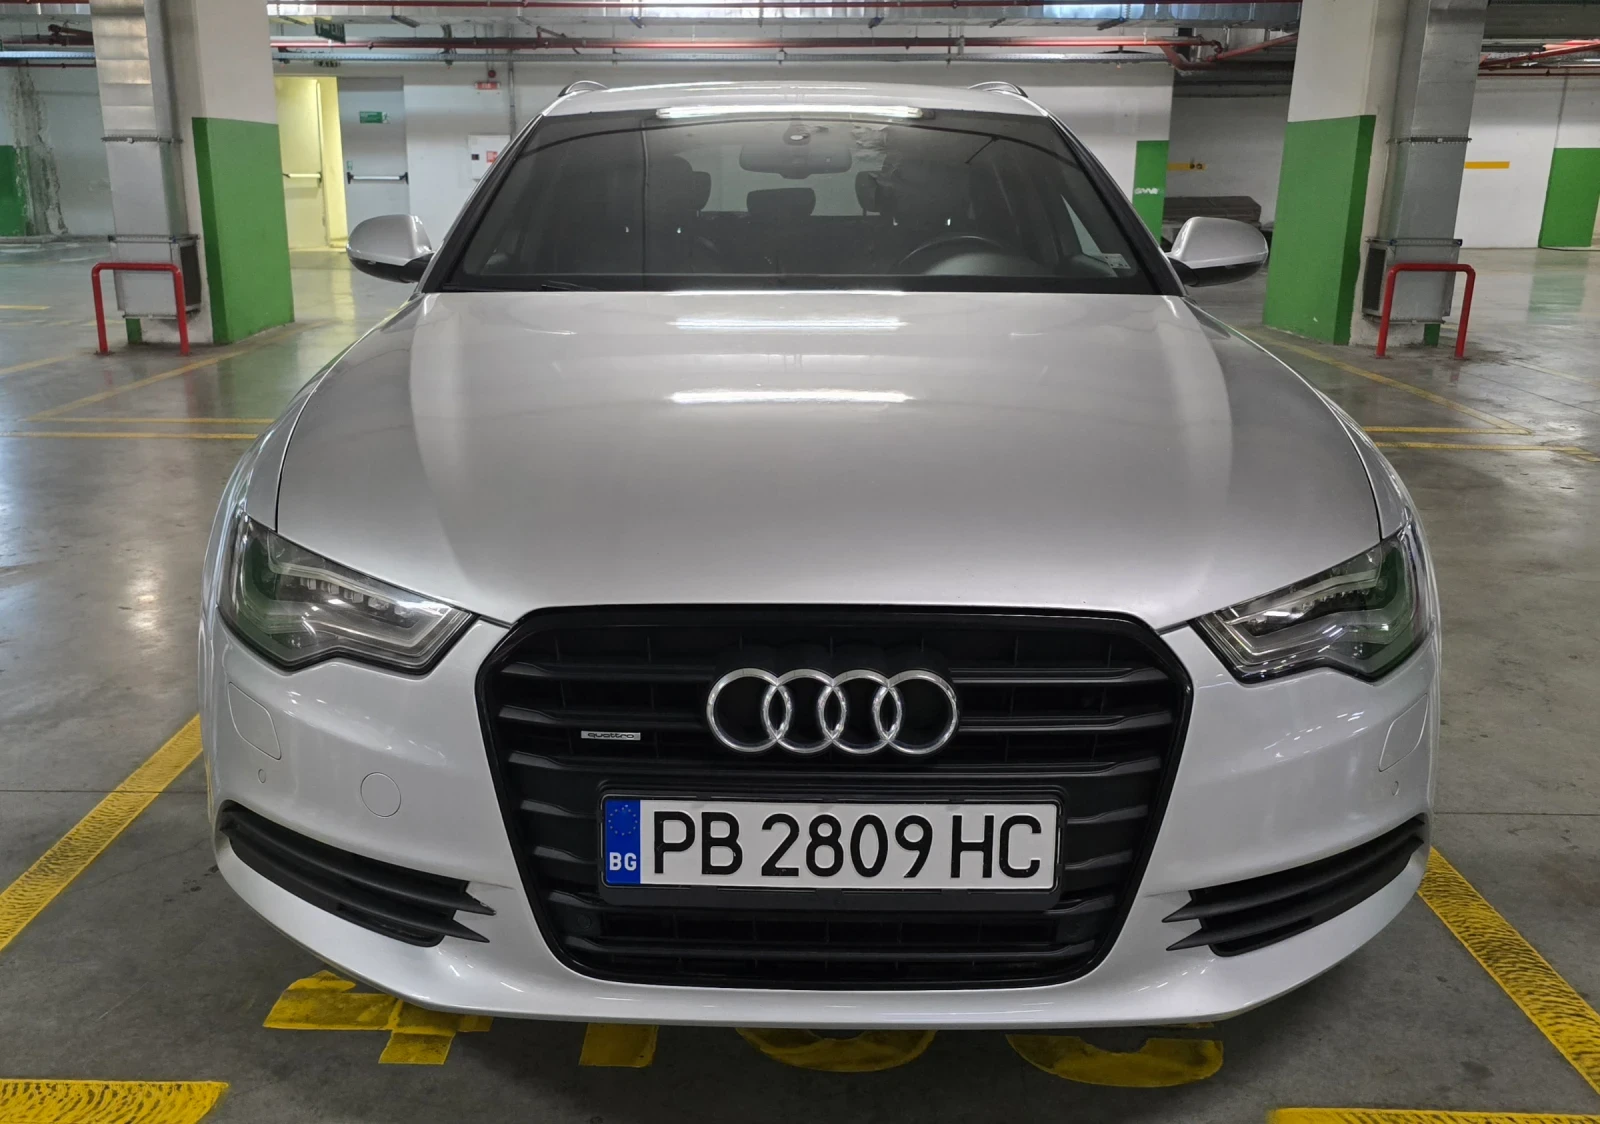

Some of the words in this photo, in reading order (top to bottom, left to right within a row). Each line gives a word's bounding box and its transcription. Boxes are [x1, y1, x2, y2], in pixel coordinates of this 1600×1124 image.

[609, 852, 637, 871] BG
[653, 810, 743, 875] PB
[760, 813, 933, 878] 2809
[950, 814, 1042, 879] HC
